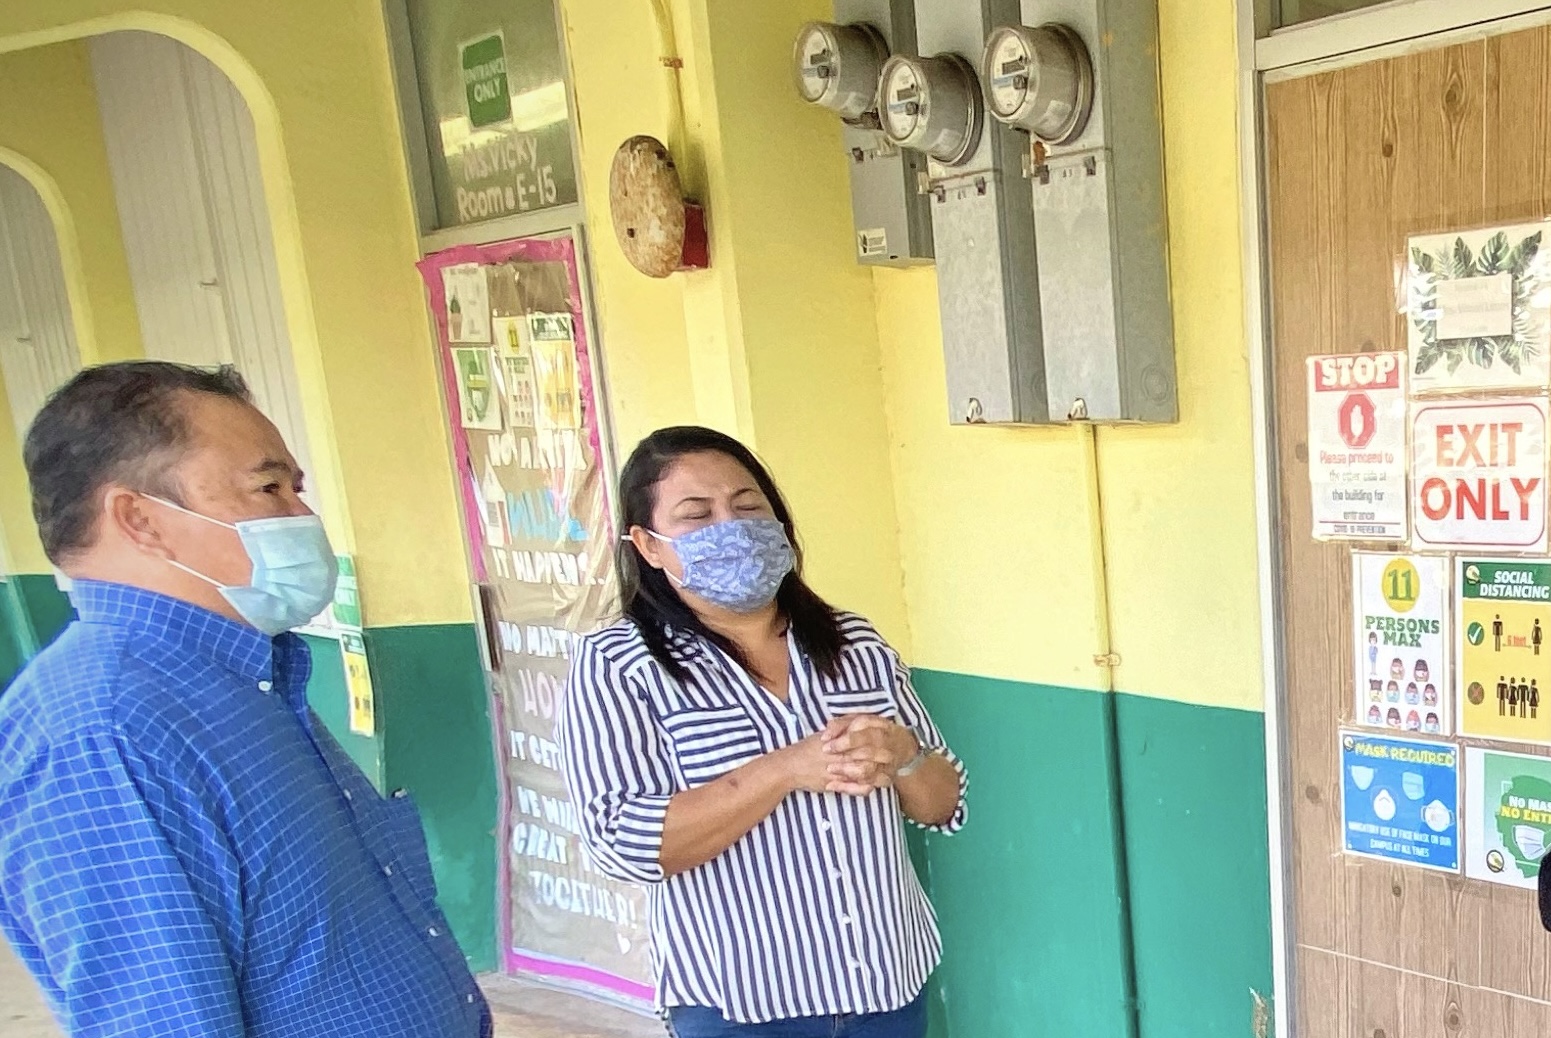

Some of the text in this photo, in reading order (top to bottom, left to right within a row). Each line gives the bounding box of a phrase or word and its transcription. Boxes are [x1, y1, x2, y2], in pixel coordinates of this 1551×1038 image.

[474, 78, 501, 103] ONLY
[457, 186, 504, 223] Room
[517, 164, 557, 210] E-15
[1320, 355, 1396, 387] STOP
[1436, 422, 1523, 467] EXIT
[1320, 450, 1346, 465] Please
[1385, 452, 1394, 464] to
[1332, 488, 1384, 504] the building for
[1420, 477, 1541, 521] ONLY
[1387, 568, 1416, 601] 11
[1494, 570, 1534, 585] SOCIAL
[1479, 583, 1550, 599] DISTANCING
[498, 621, 522, 654] NO
[1365, 615, 1440, 635] PERSONS
[1383, 630, 1422, 648] MAX
[1355, 743, 1455, 768] MASK REQUIRED
[1500, 805, 1520, 818] NO
[1508, 795, 1525, 808] NO
[528, 870, 638, 930] TOGETHER!
